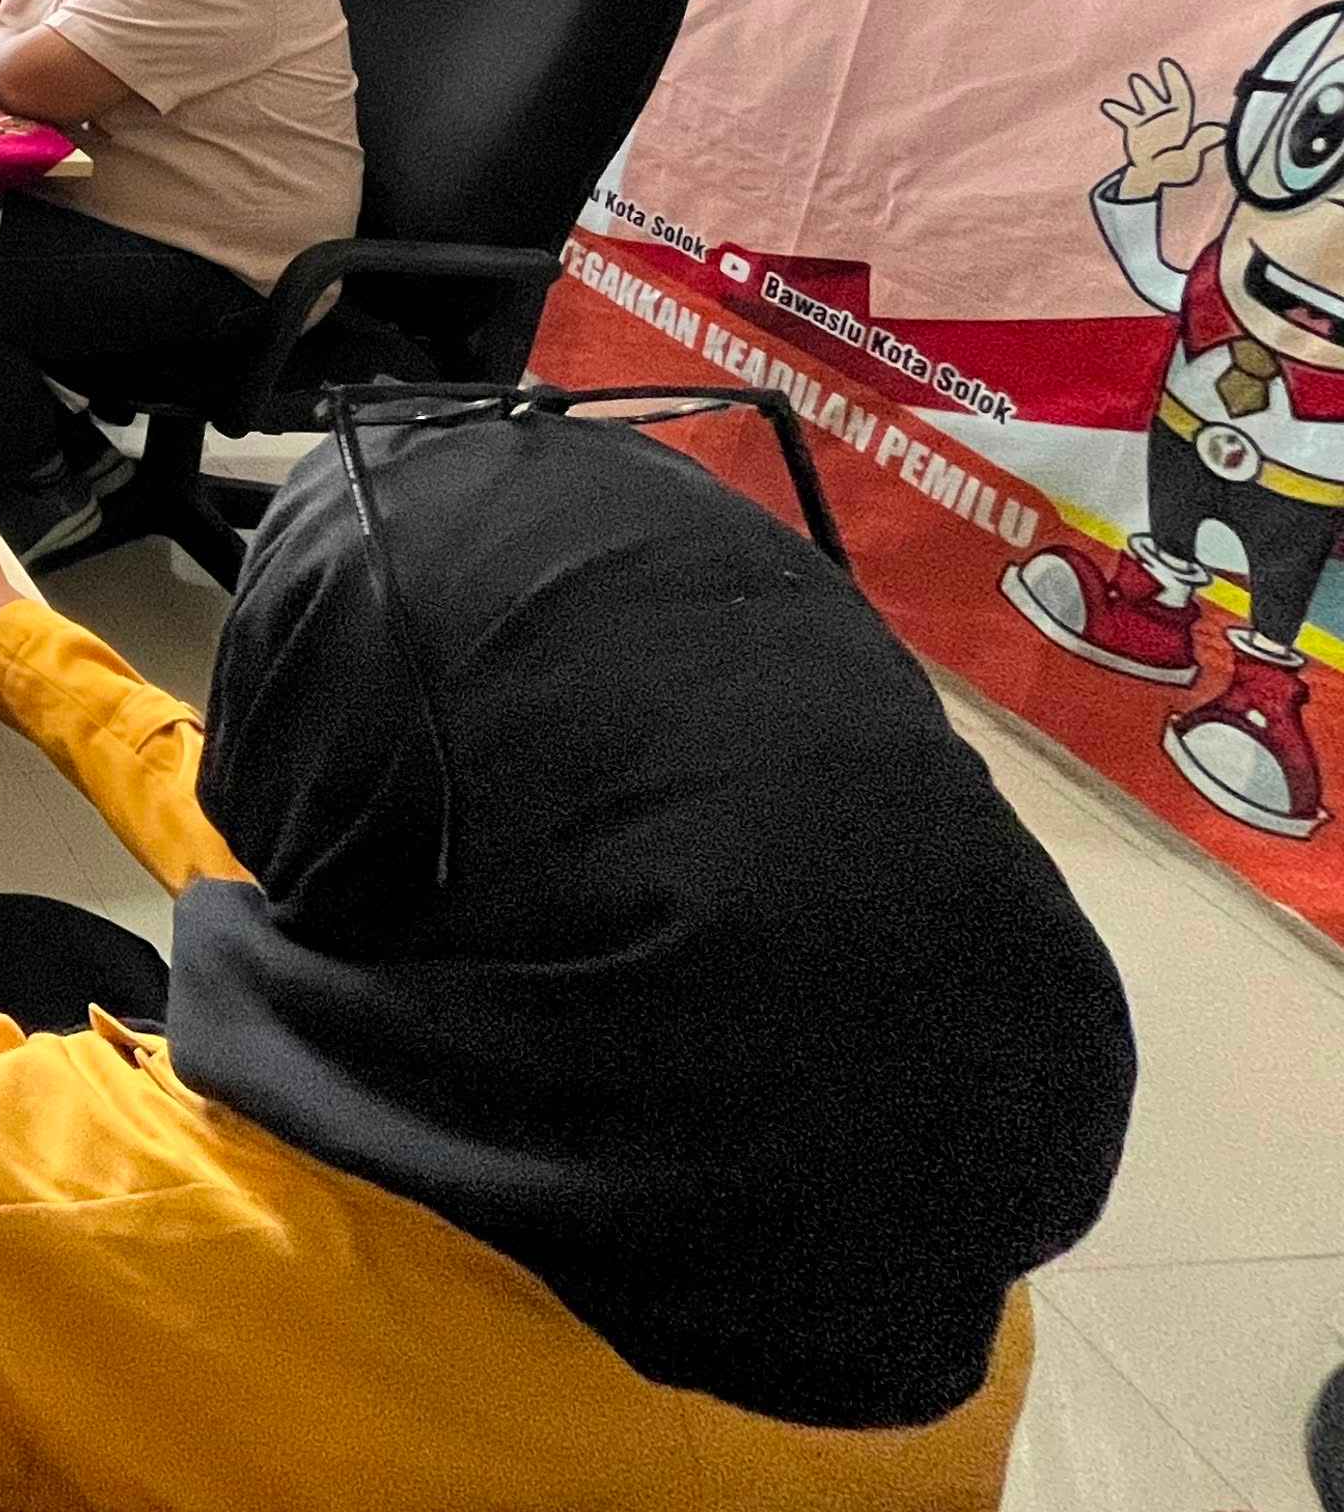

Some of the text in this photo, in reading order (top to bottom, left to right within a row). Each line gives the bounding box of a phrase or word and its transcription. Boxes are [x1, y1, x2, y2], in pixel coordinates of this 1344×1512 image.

[604, 190, 707, 261] Kota Solok
[764, 273, 1014, 425] Bawaslu Kota Solok
[702, 321, 879, 454] KEADILAN
[875, 424, 1041, 550] PEMILU
